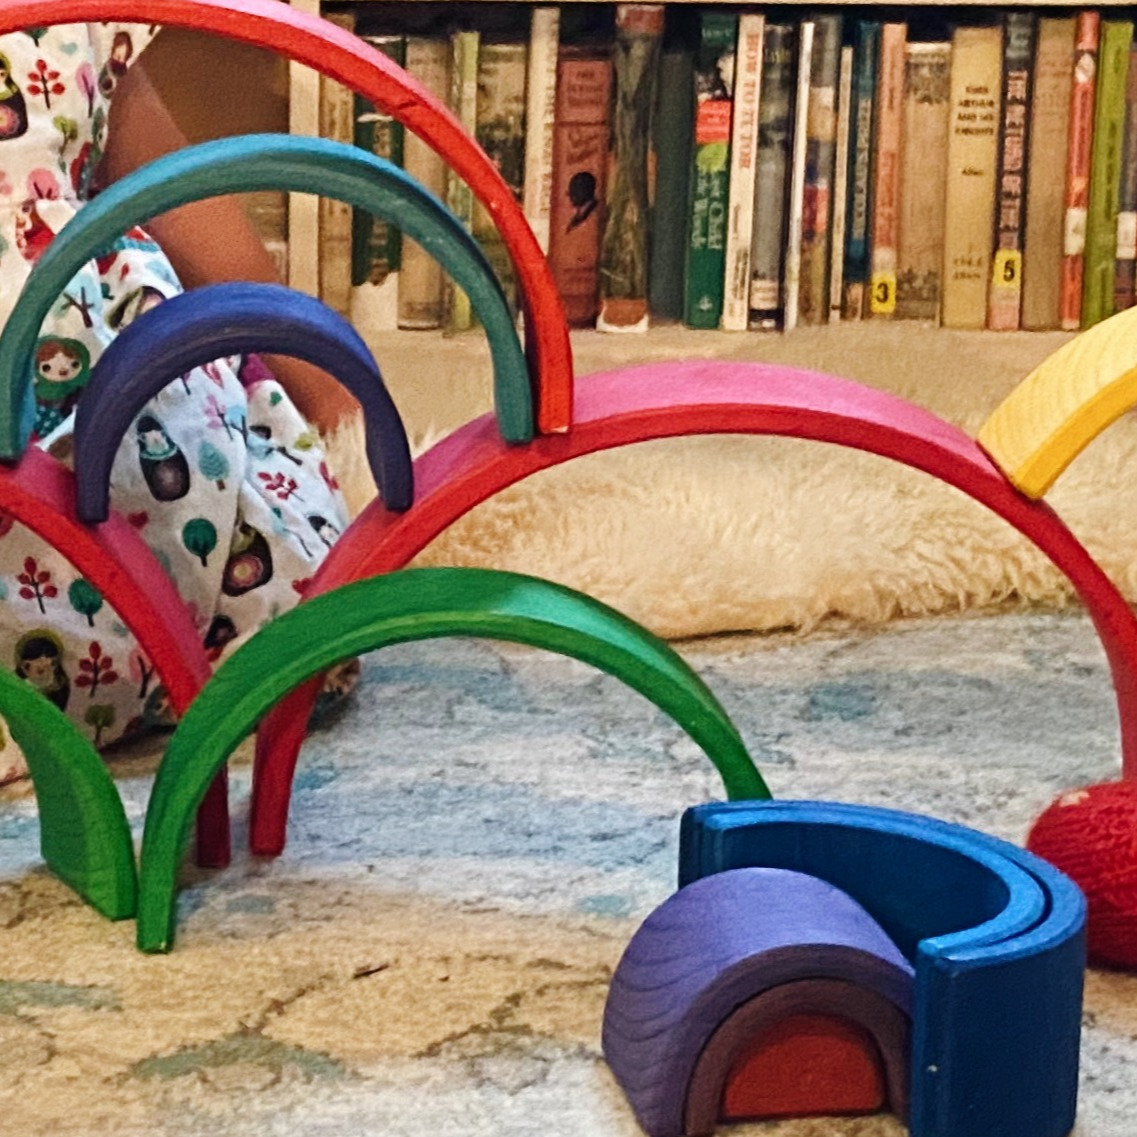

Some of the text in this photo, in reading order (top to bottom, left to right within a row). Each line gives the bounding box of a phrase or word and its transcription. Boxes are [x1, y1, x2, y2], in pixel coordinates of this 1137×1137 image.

[1007, 70, 1028, 100] THE
[739, 33, 759, 170] HOW TO TUTOR
[1005, 103, 1027, 172] RETURN
[1002, 174, 1023, 195] OF
[1000, 198, 1021, 229] THE
[1003, 260, 1015, 282] 5
[876, 282, 889, 303] 3
